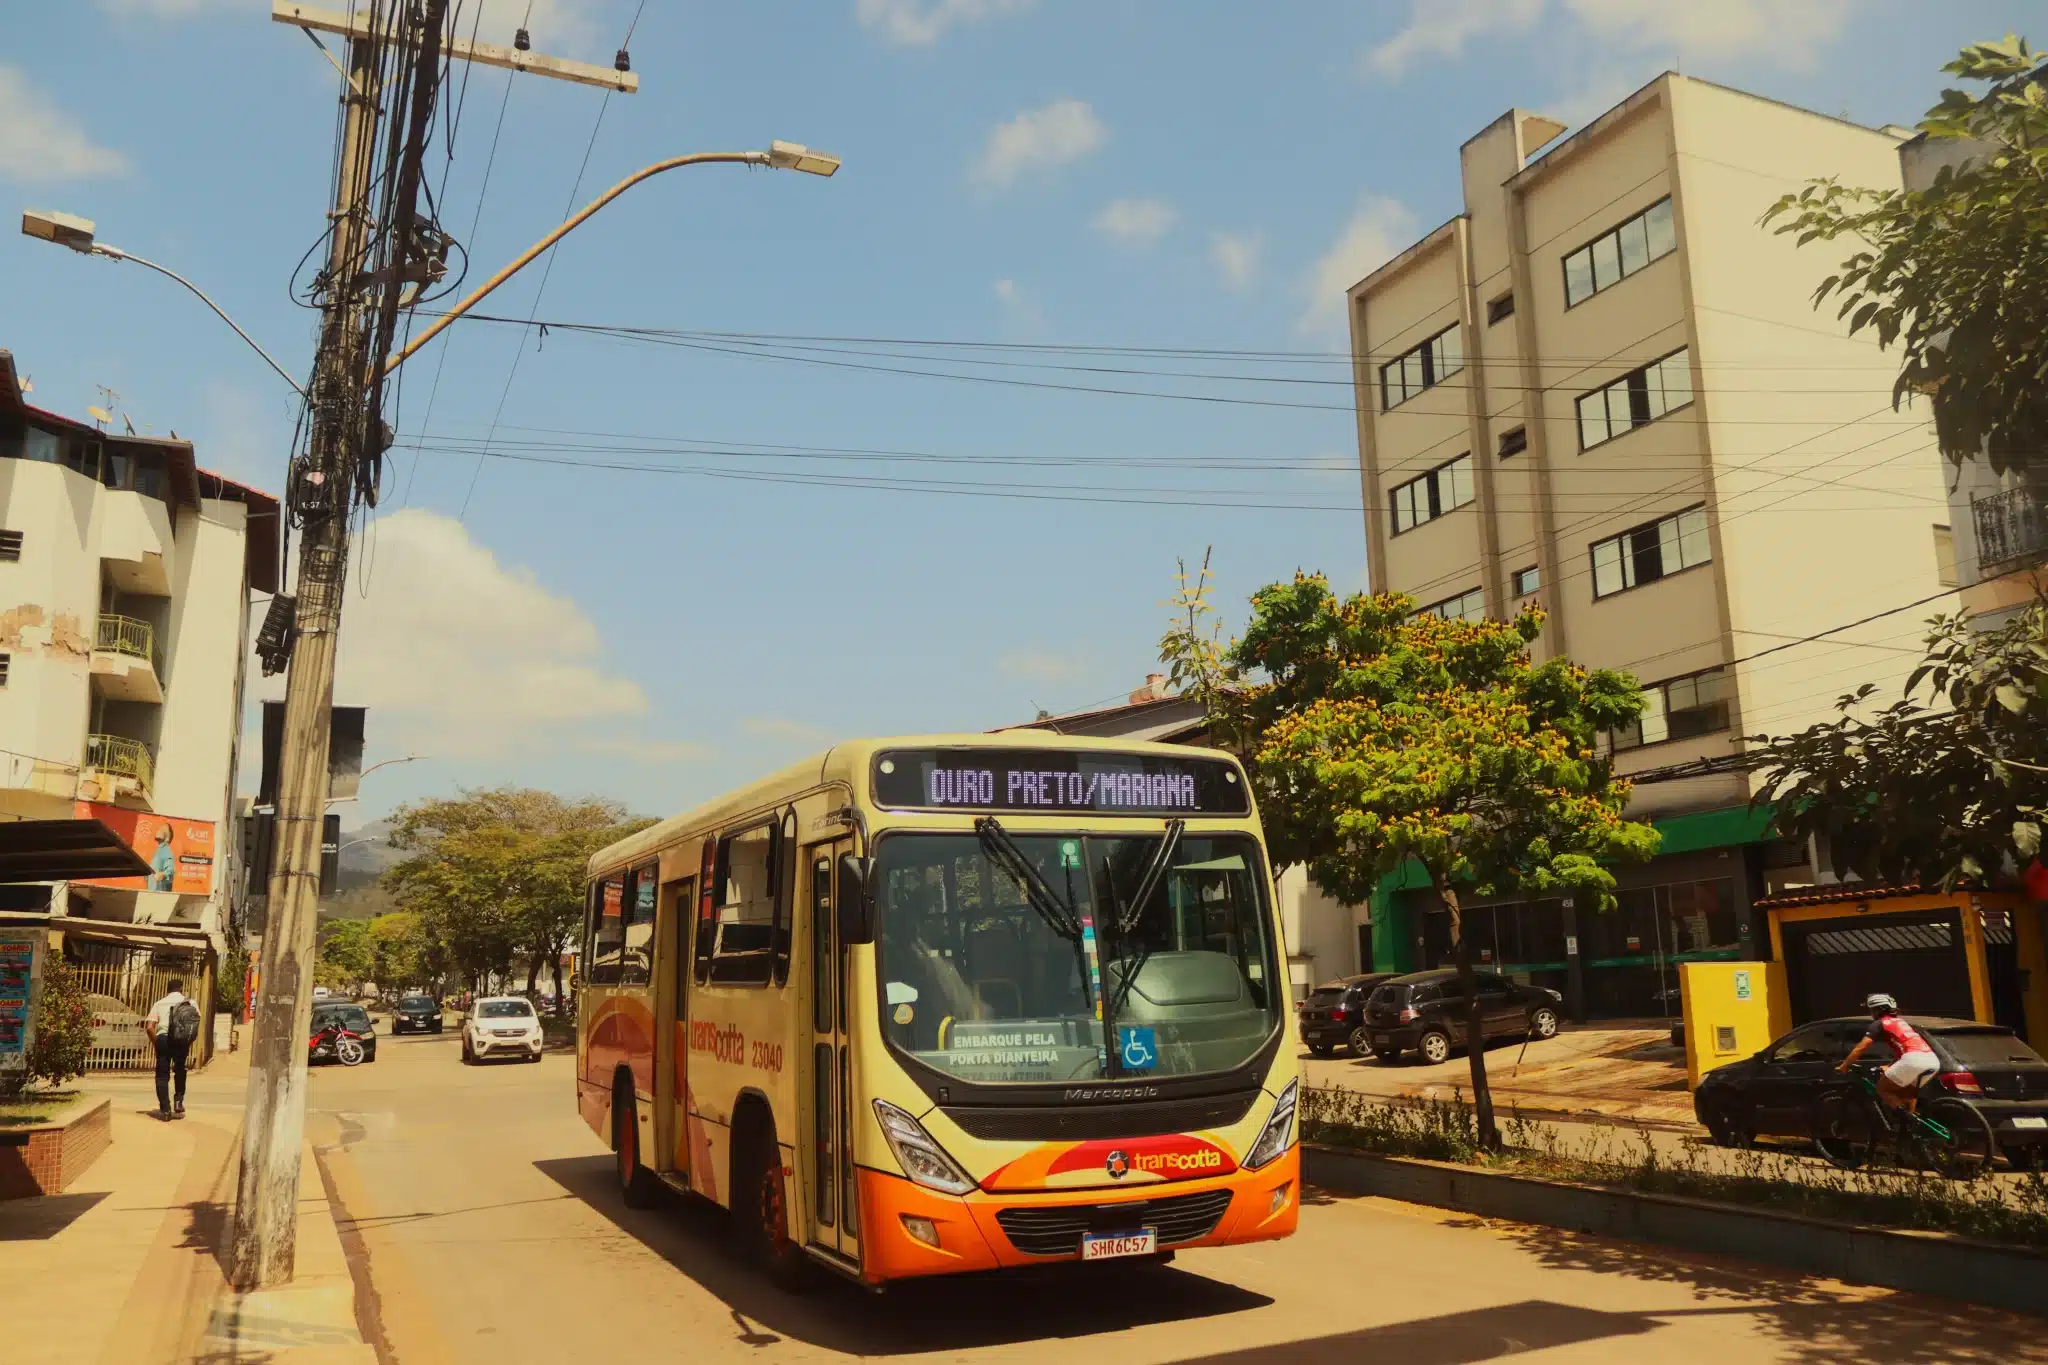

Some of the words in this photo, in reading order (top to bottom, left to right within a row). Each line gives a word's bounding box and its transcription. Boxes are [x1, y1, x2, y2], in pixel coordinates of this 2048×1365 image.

[931, 769, 993, 803] OURO
[690, 1013, 745, 1065] transcotta
[954, 1034, 1022, 1048] EMBARQUE
[1025, 1033, 1056, 1046] PELA
[752, 1040, 783, 1073] 23040
[949, 1053, 991, 1065] PORTA
[993, 1050, 1059, 1063] DIANTEIRA
[1064, 1086, 1158, 1101] Marcopolo
[1134, 1149, 1221, 1171] transcotta
[1091, 1237, 1148, 1257] SHR6C57
